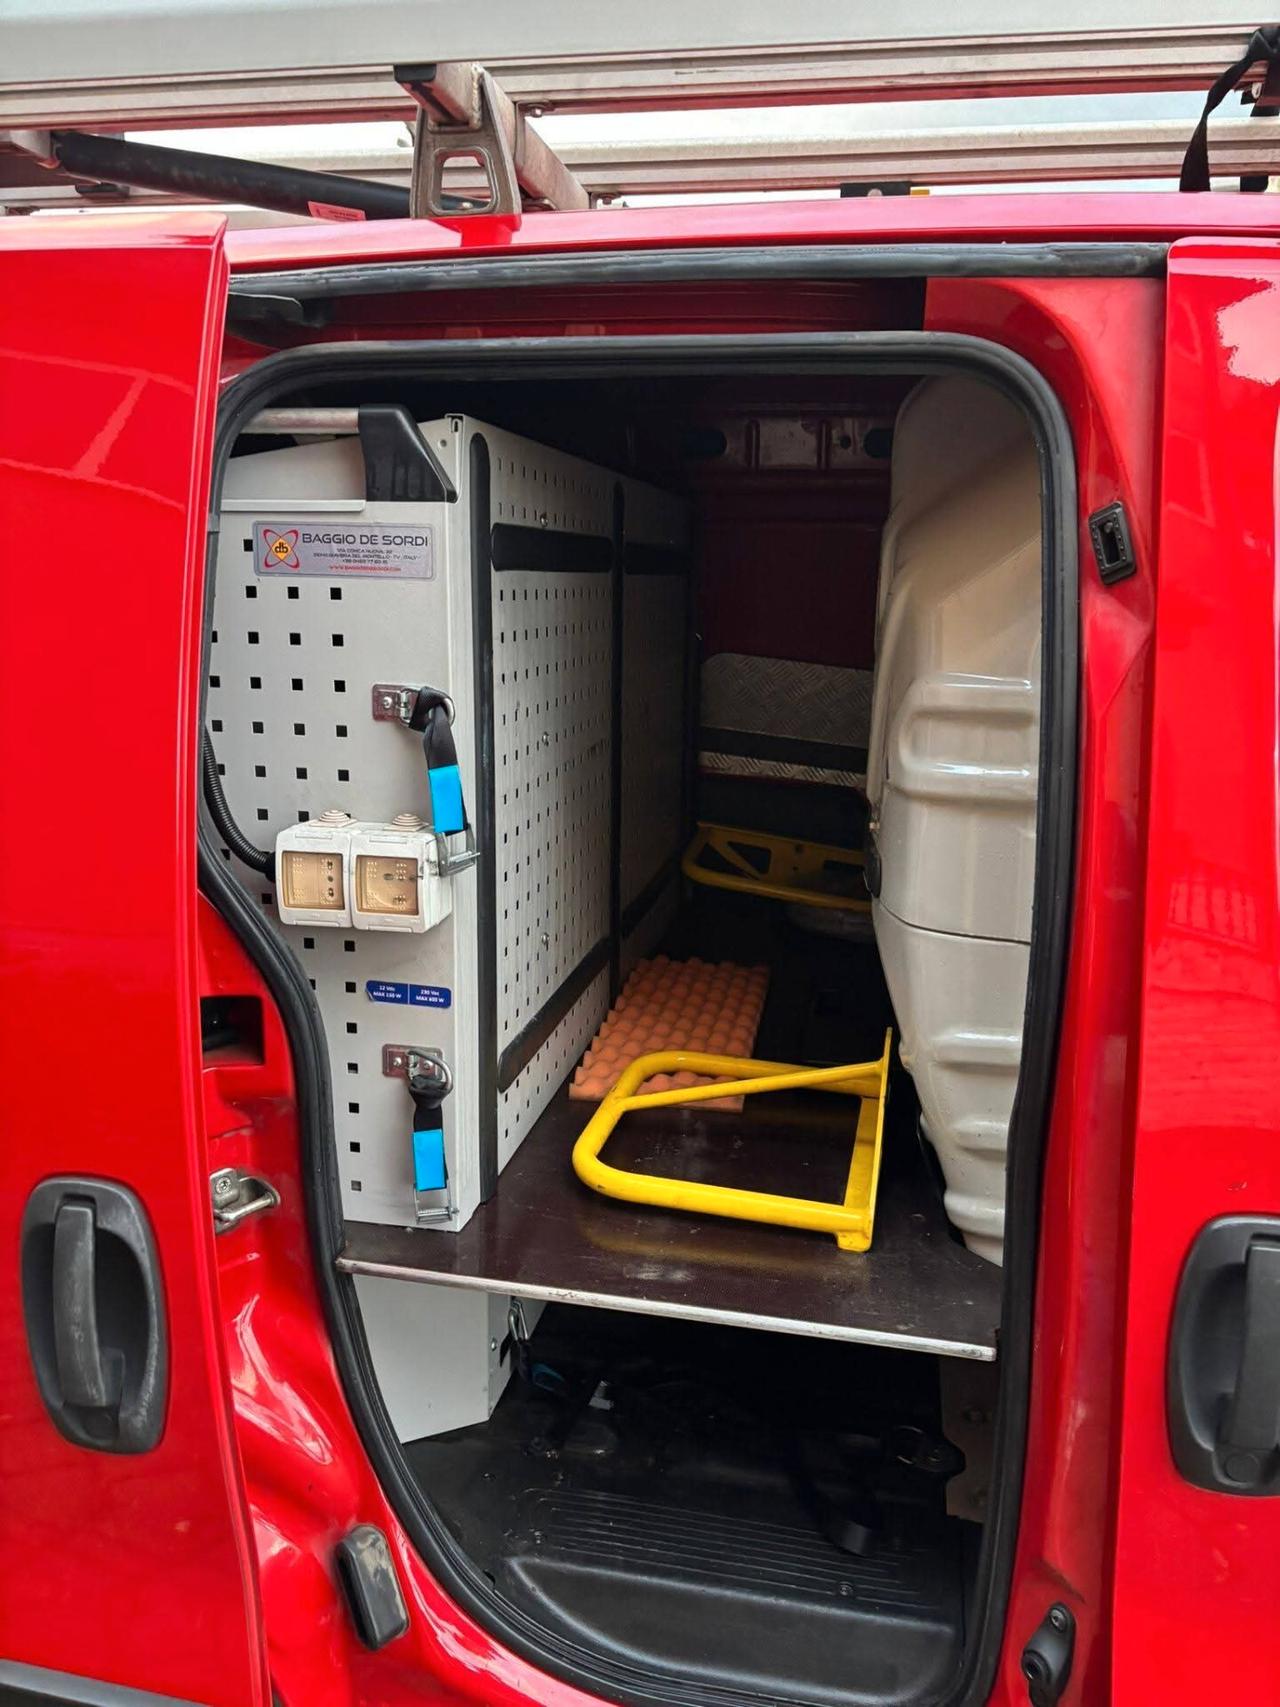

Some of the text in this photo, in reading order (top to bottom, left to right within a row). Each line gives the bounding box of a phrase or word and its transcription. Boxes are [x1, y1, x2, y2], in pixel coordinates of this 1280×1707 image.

[302, 533, 428, 547] BAGGIO DE SORDI
